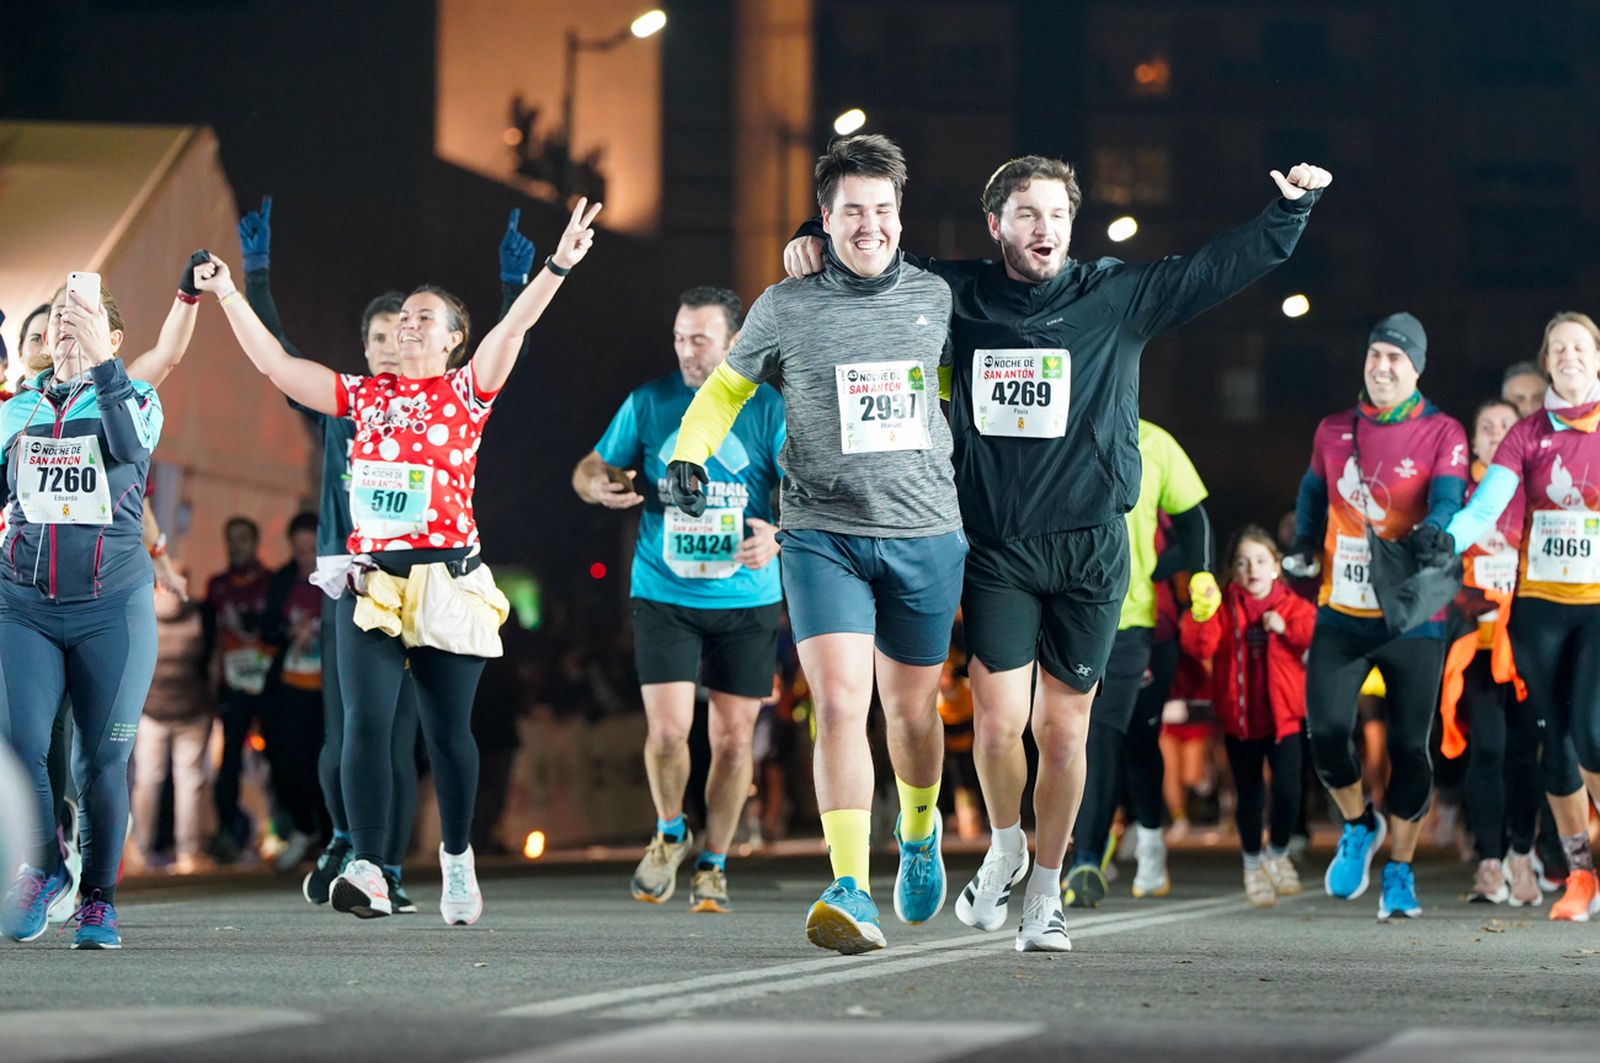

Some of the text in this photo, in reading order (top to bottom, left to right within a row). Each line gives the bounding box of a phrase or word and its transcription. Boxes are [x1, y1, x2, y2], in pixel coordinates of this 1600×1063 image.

[994, 359, 1022, 368] NOCHE
[1023, 358, 1035, 367] DE
[983, 370, 1002, 380] SAN
[849, 383, 869, 394] SAN
[991, 380, 1052, 407] 4269
[860, 393, 916, 422] 2937
[42, 446, 70, 455] NOCHE
[70, 445, 82, 454] DE
[29, 456, 49, 465] SAN
[37, 467, 97, 493] 7260
[361, 479, 376, 487] SAN
[53, 494, 78, 502] Eduardo
[371, 490, 408, 513] 510
[674, 534, 733, 554] 13424
[1542, 538, 1591, 557] 4969
